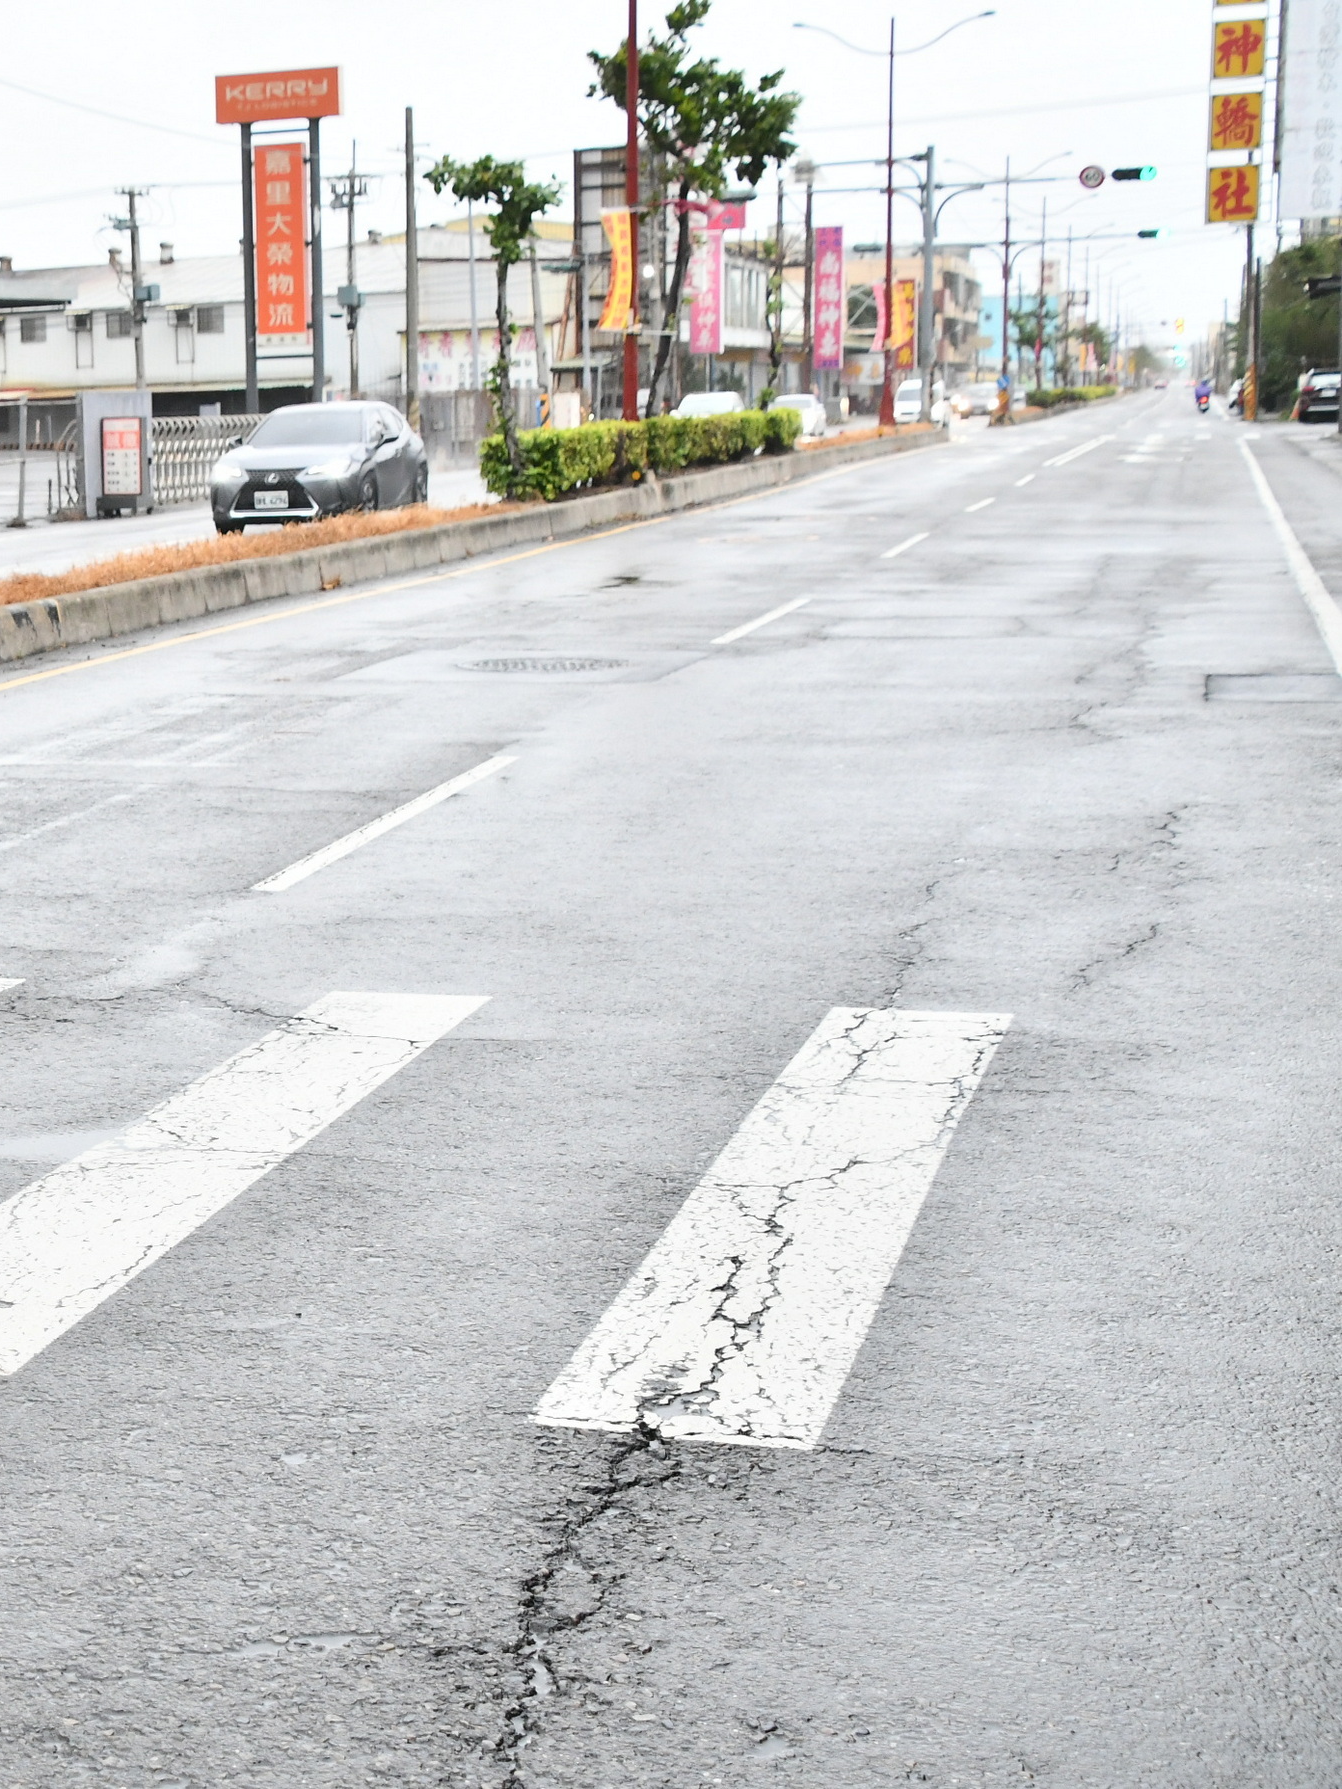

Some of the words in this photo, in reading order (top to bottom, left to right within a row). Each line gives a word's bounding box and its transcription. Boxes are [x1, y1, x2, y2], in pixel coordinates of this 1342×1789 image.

[225, 78, 328, 102] KERRY
[1212, 0, 1263, 218] 神轎社
[264, 149, 295, 327] 嘉里大榮物流
